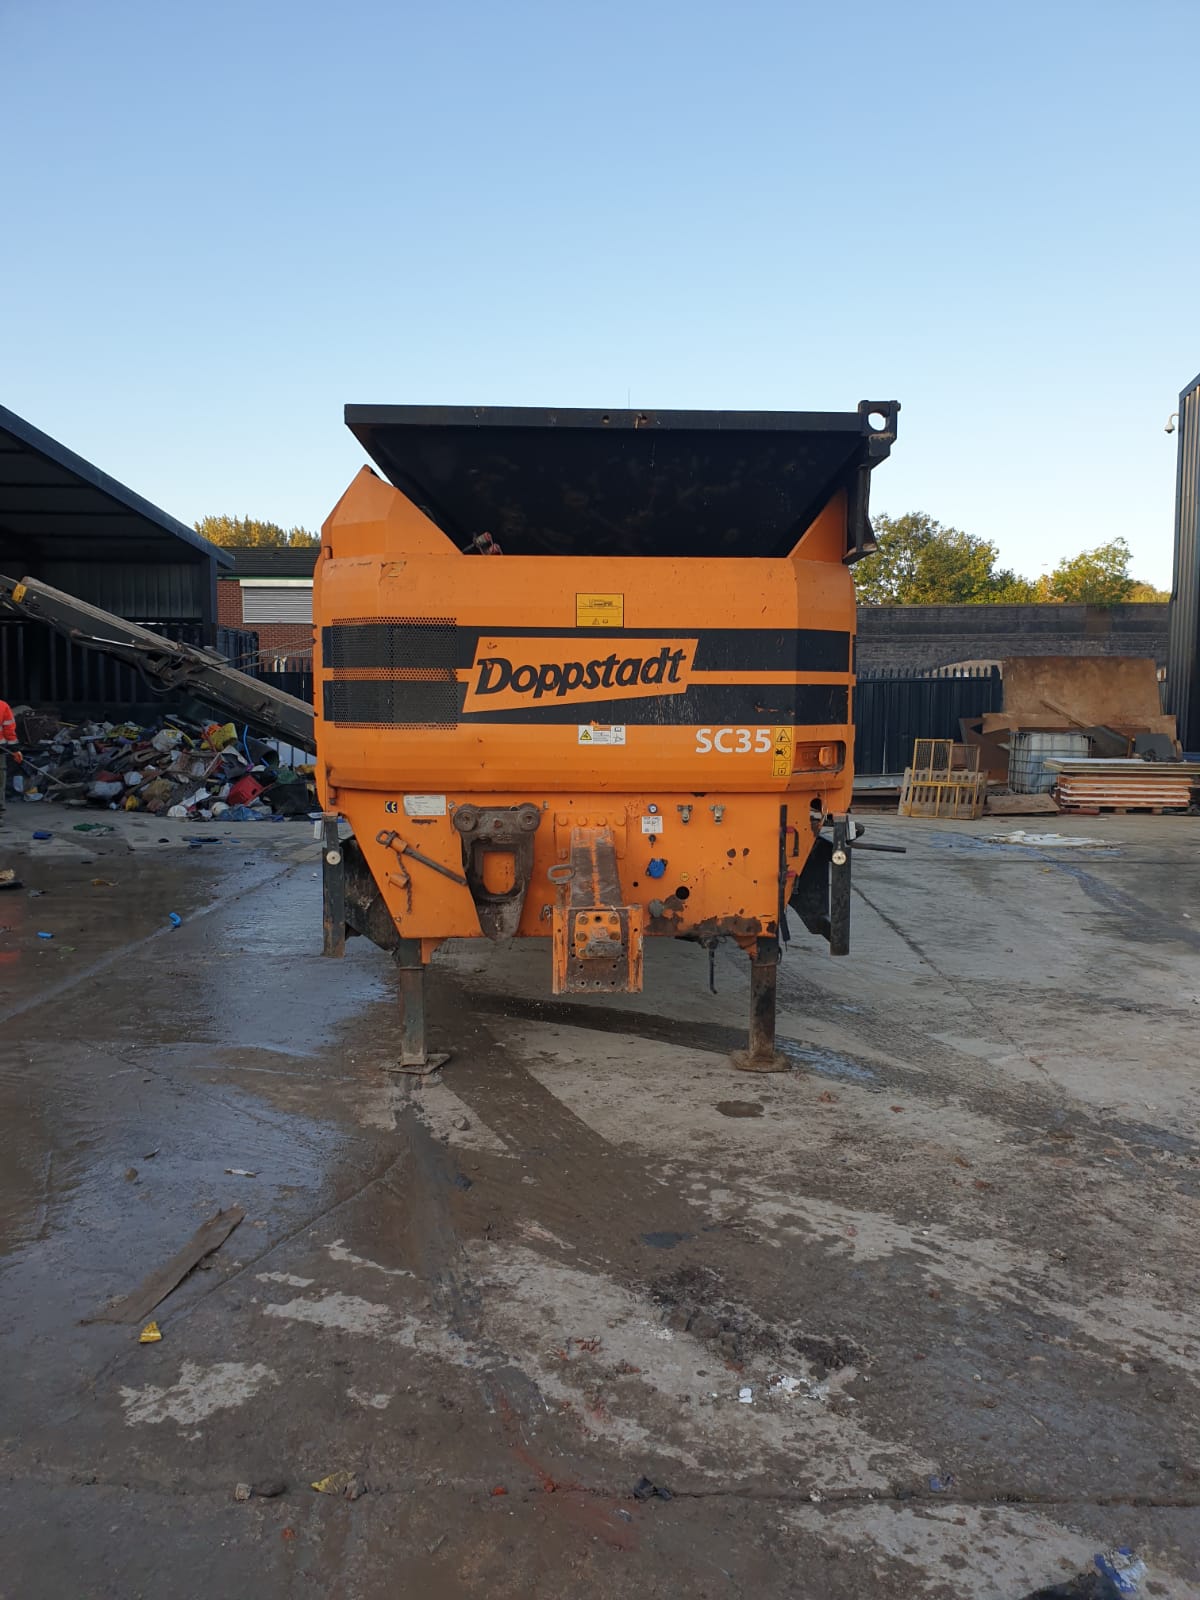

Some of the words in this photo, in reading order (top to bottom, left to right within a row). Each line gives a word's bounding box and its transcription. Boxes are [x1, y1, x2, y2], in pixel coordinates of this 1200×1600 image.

[475, 647, 687, 699] Doppstadt
[695, 728, 772, 753] SC35
[385, 801, 398, 813] CE
